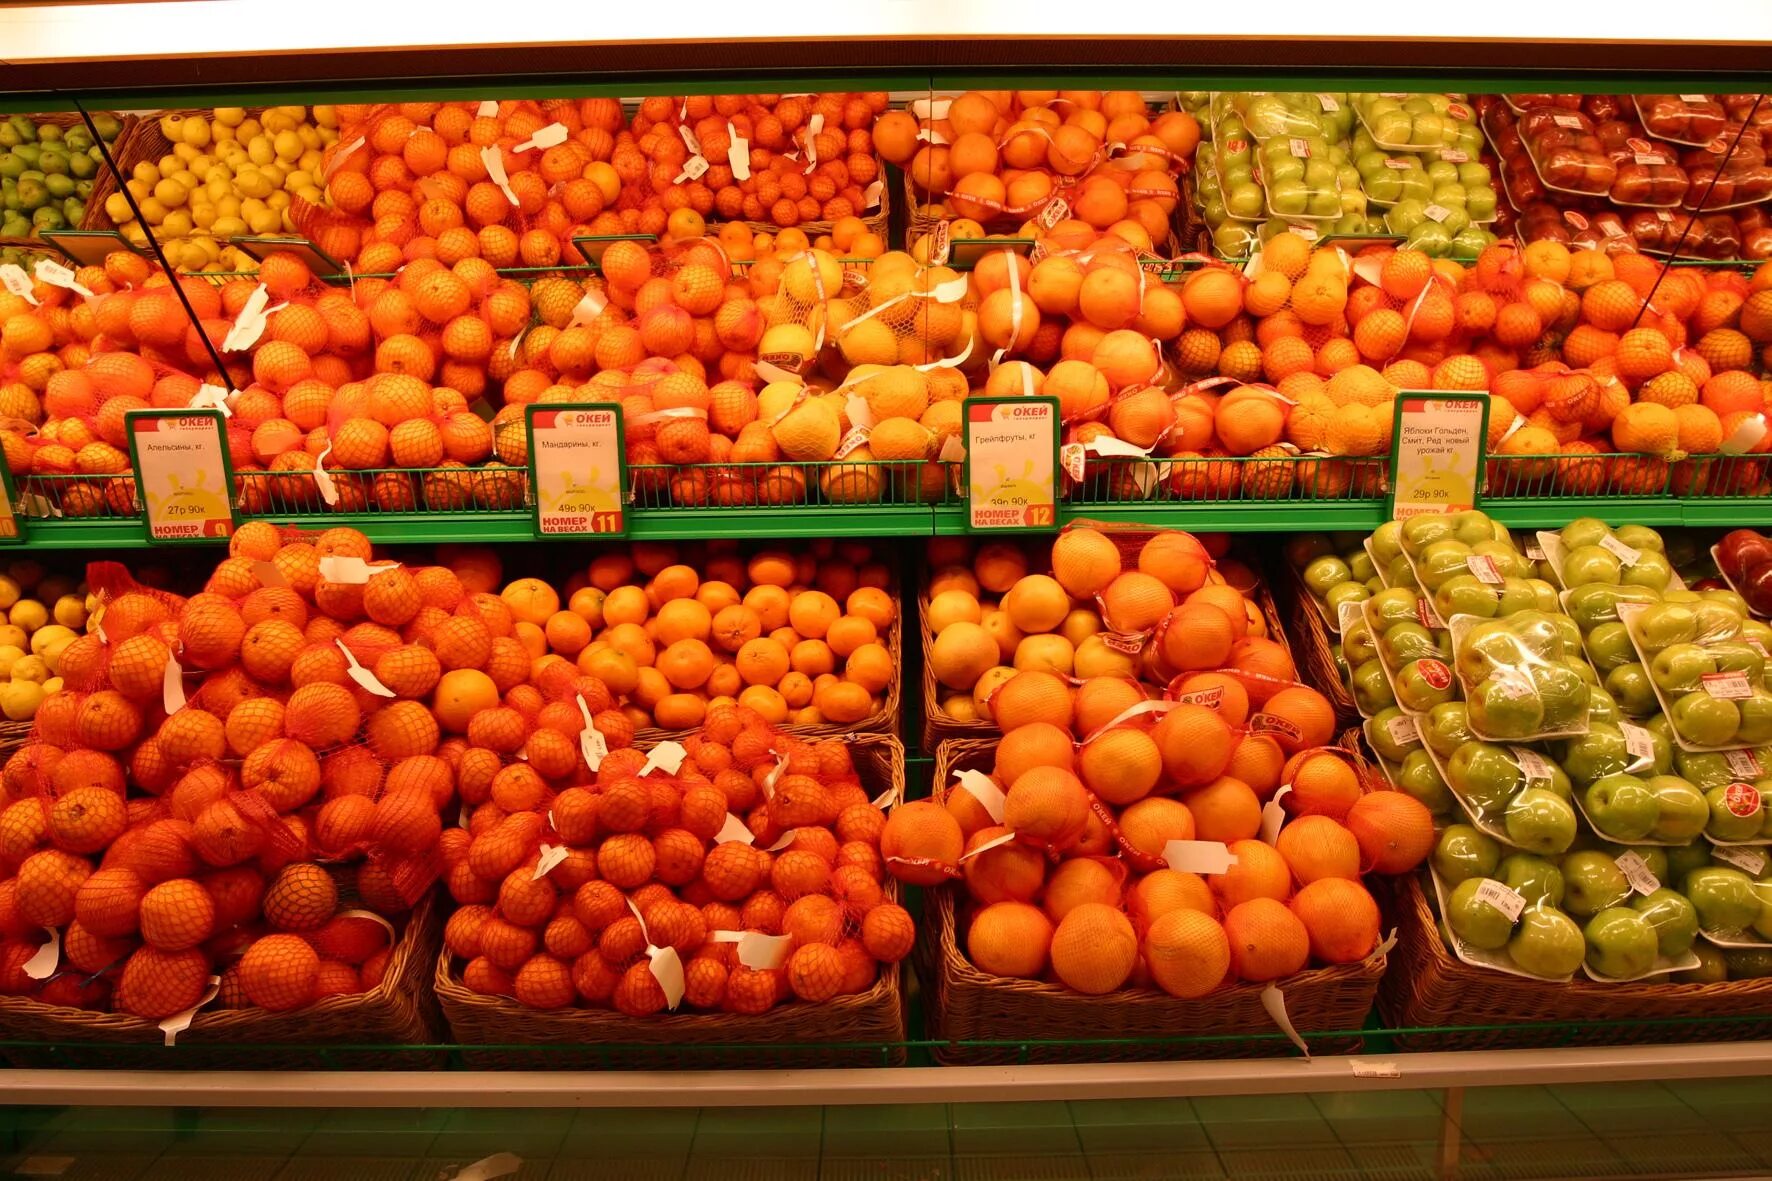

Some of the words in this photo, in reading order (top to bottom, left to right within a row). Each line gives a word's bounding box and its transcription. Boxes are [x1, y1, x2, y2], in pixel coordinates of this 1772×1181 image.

[1404, 427, 1433, 435] Яблоки
[975, 433, 1027, 445] Грейпфруты,
[147, 444, 194, 452] Апельсины,
[542, 441, 591, 449] Мандарины,
[1417, 447, 1445, 456] урожай
[1413, 489, 1431, 500] 29р
[1433, 489, 1449, 498] 90к
[1011, 497, 1028, 505] 90к
[168, 506, 186, 516] 27р
[188, 505, 206, 514] 90к
[558, 504, 577, 513] 49р
[578, 503, 596, 512] 90к
[974, 510, 1020, 519] НОМЕР
[1031, 508, 1051, 526] 12
[542, 517, 588, 526] НОМЕР
[597, 514, 616, 533] 11
[975, 518, 989, 526] НА
[154, 525, 199, 534] НОМЕР
[215, 523, 228, 537] 9
[543, 525, 559, 533] НА
[559, 525, 588, 533] ВЕСАХ
